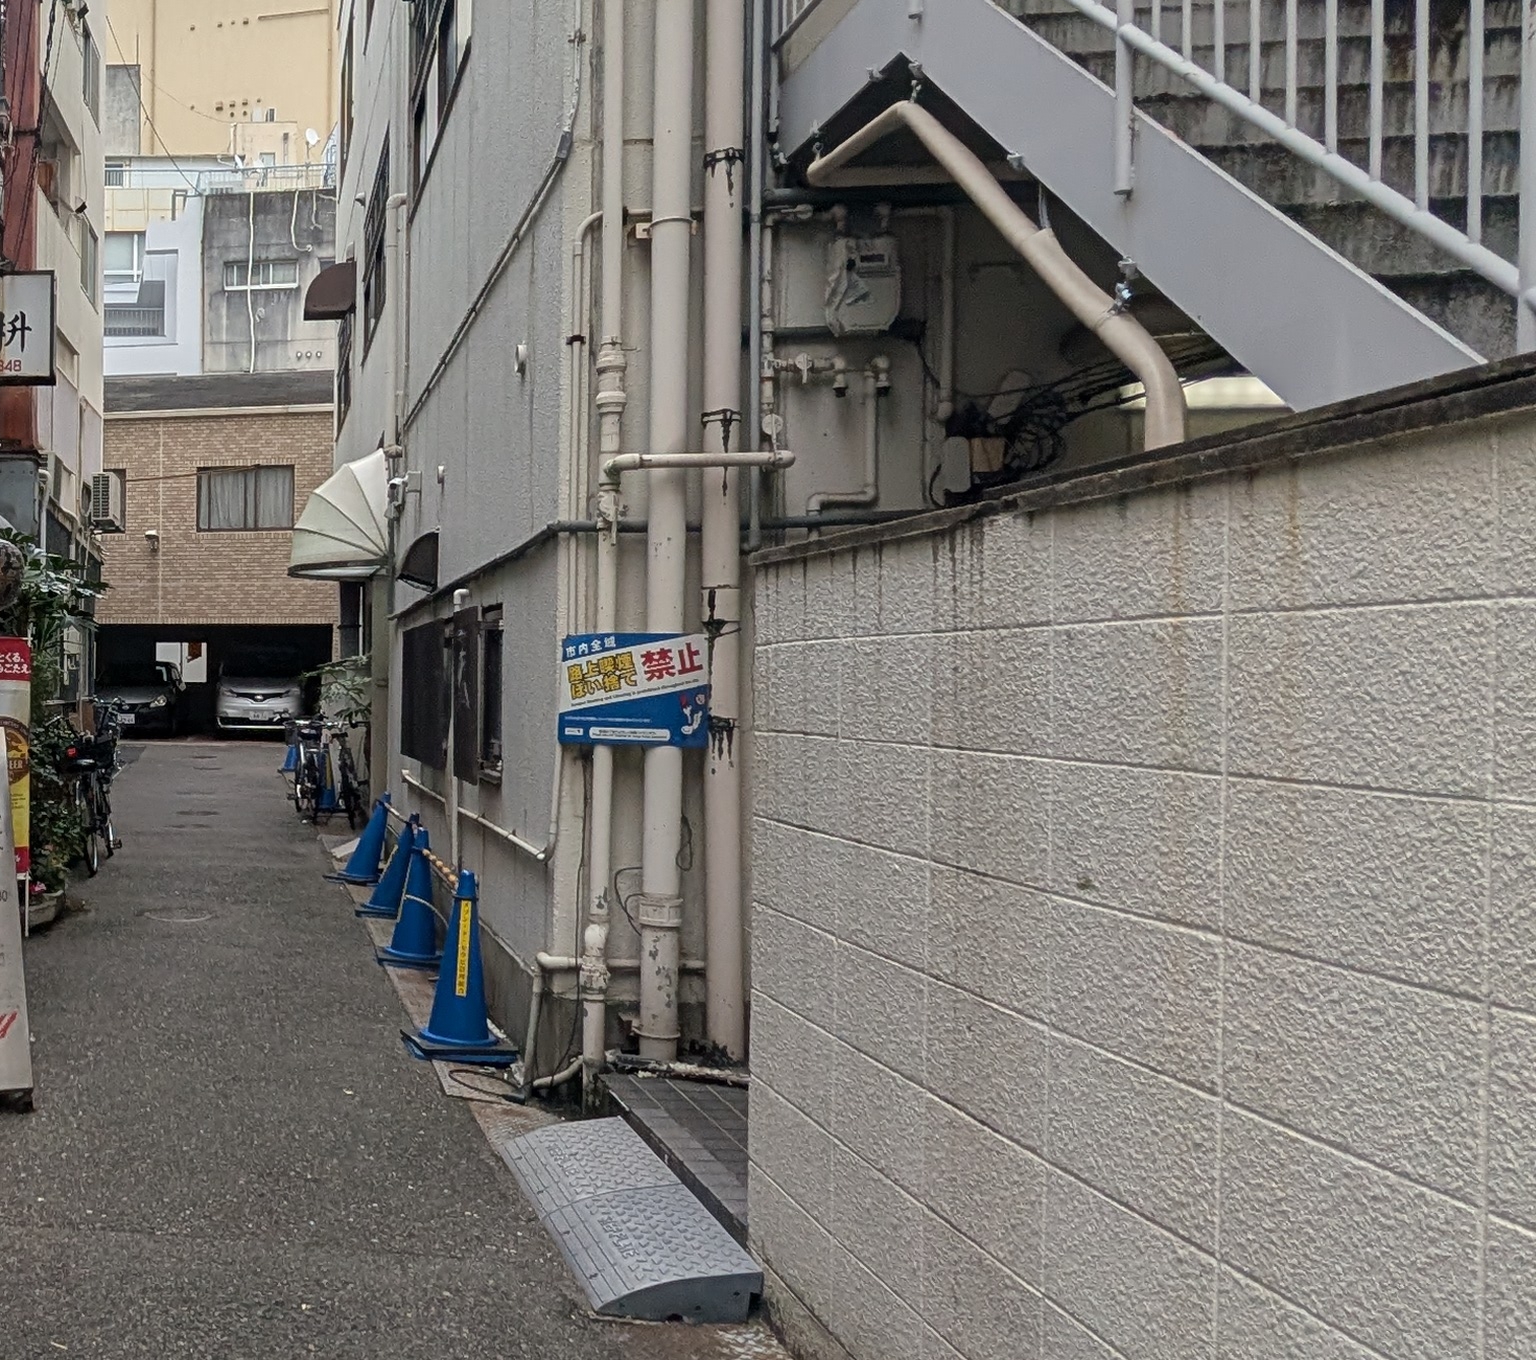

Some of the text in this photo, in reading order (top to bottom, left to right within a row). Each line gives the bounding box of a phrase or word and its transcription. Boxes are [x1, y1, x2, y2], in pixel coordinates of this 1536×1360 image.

[565, 636, 617, 658] 市内全域
[640, 642, 704, 682] 禁止
[567, 651, 636, 683] 路上喫煙
